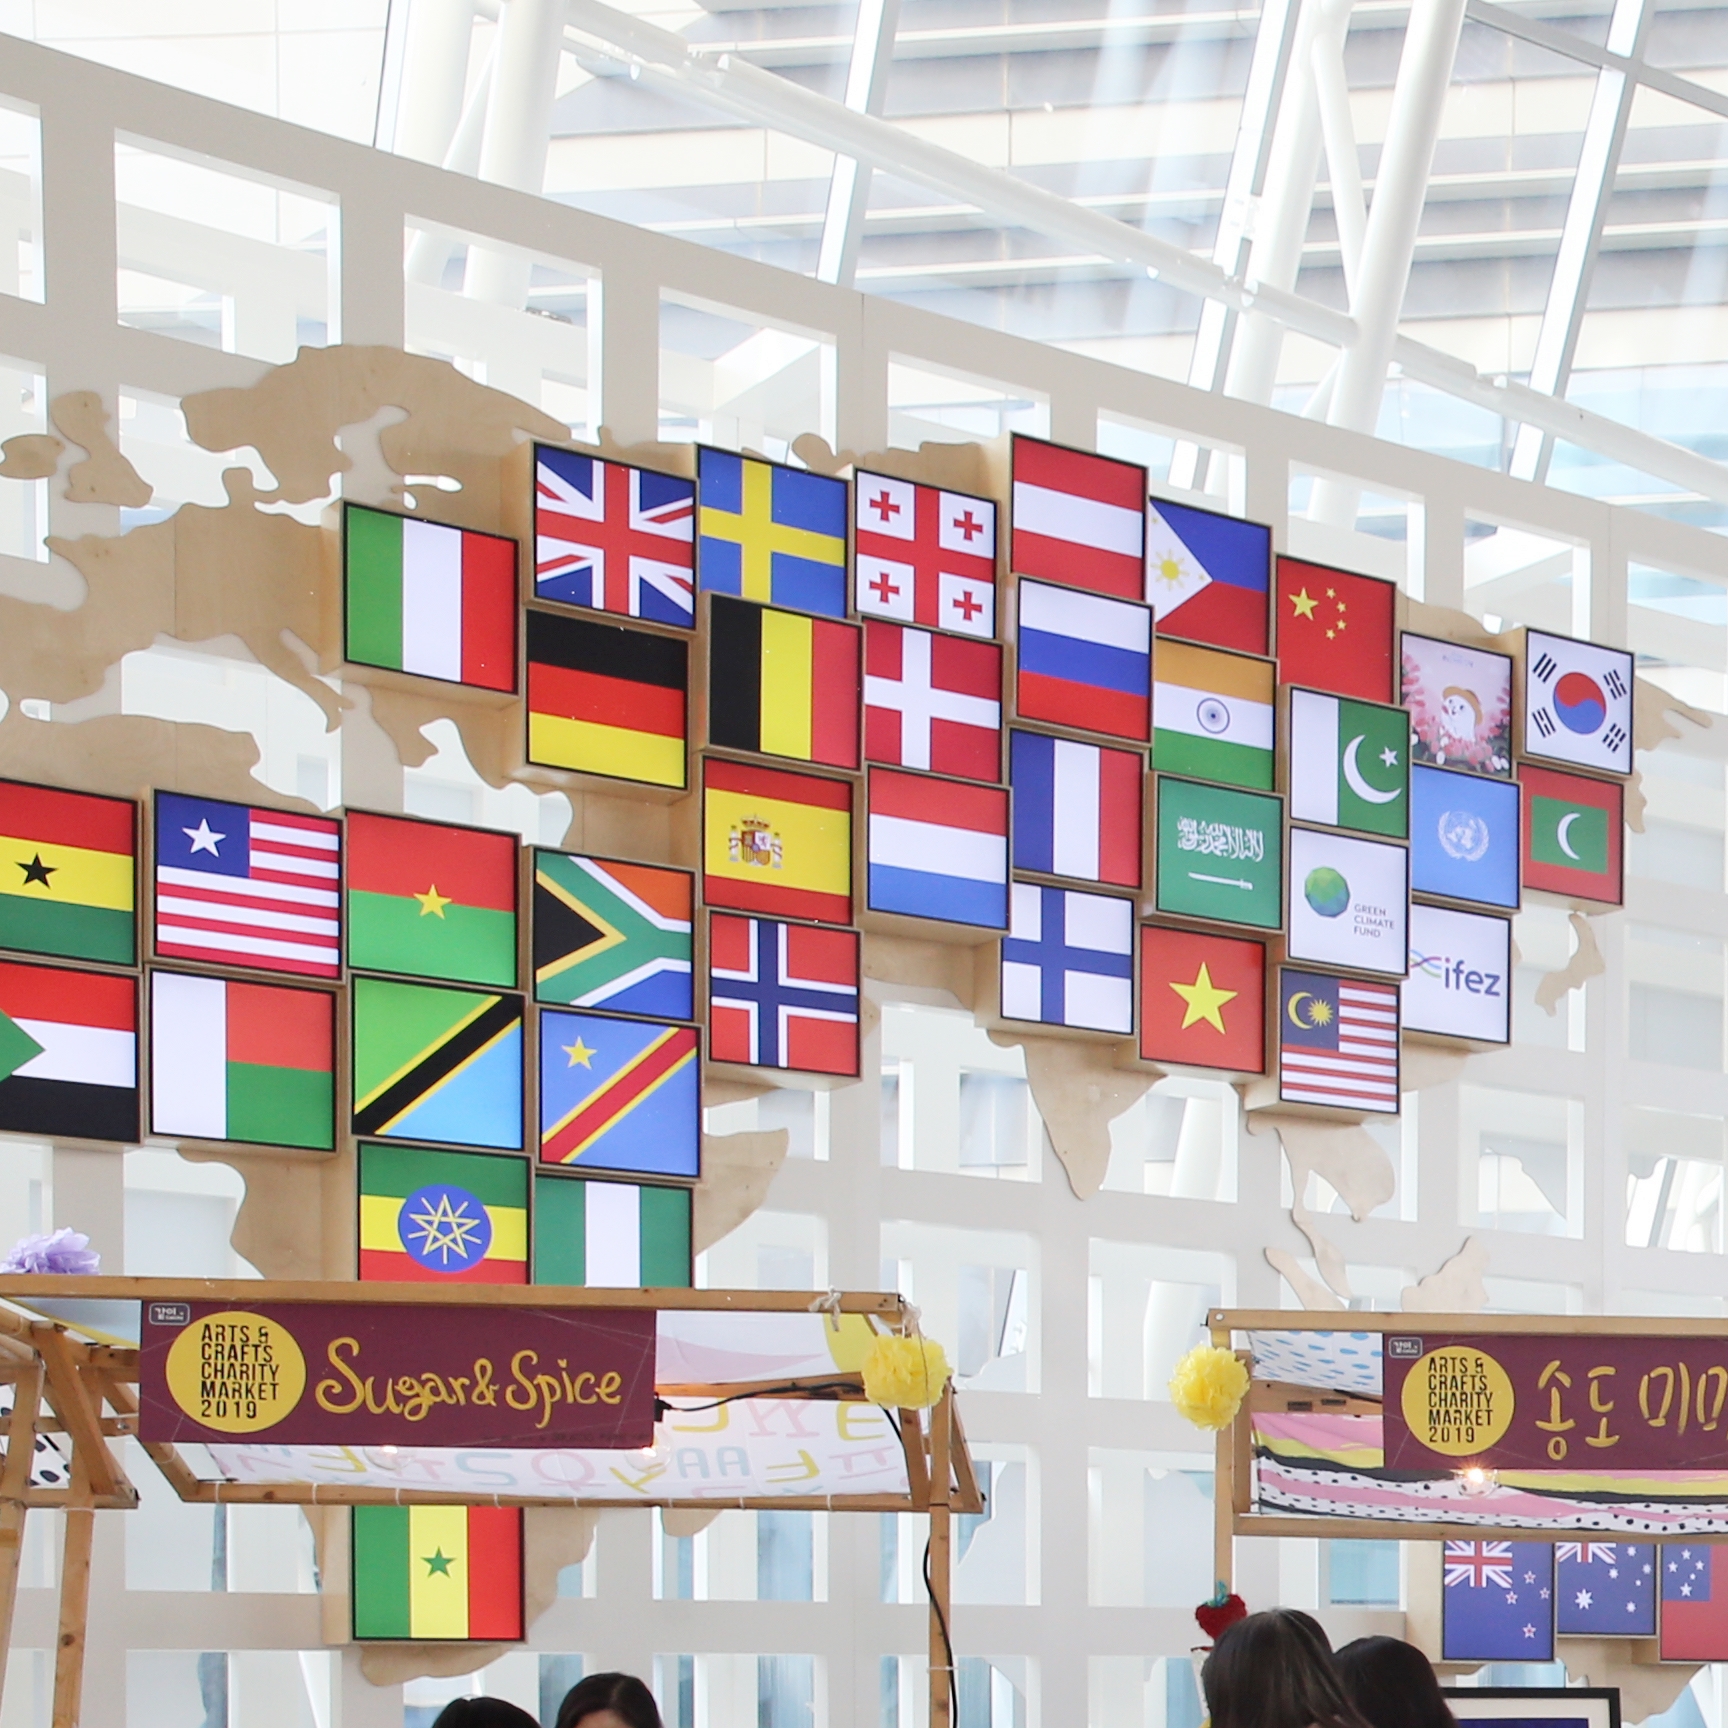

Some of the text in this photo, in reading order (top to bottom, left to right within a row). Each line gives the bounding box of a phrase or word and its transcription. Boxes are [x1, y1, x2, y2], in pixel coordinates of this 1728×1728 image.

[1354, 903, 1387, 918] GREEN
[1353, 926, 1382, 939] FUND
[1354, 915, 1395, 931] CLIMATE
[1444, 957, 1501, 997] ifez
[201, 1323, 269, 1344] ARTS &
[201, 1342, 273, 1362] CRAFTS
[201, 1361, 280, 1382] CHARITY
[1428, 1356, 1484, 1374] ARTS &
[201, 1380, 280, 1401] MARKET
[315, 1336, 470, 1422] Sugar
[504, 1350, 622, 1429] Spice
[1428, 1374, 1488, 1391] CRAFTS
[201, 1399, 257, 1419] 2019
[1428, 1391, 1494, 1408] CHARITY
[1428, 1409, 1494, 1426] MARKET
[1535, 1359, 1621, 1461] 송도
[1429, 1426, 1475, 1443] 2019
